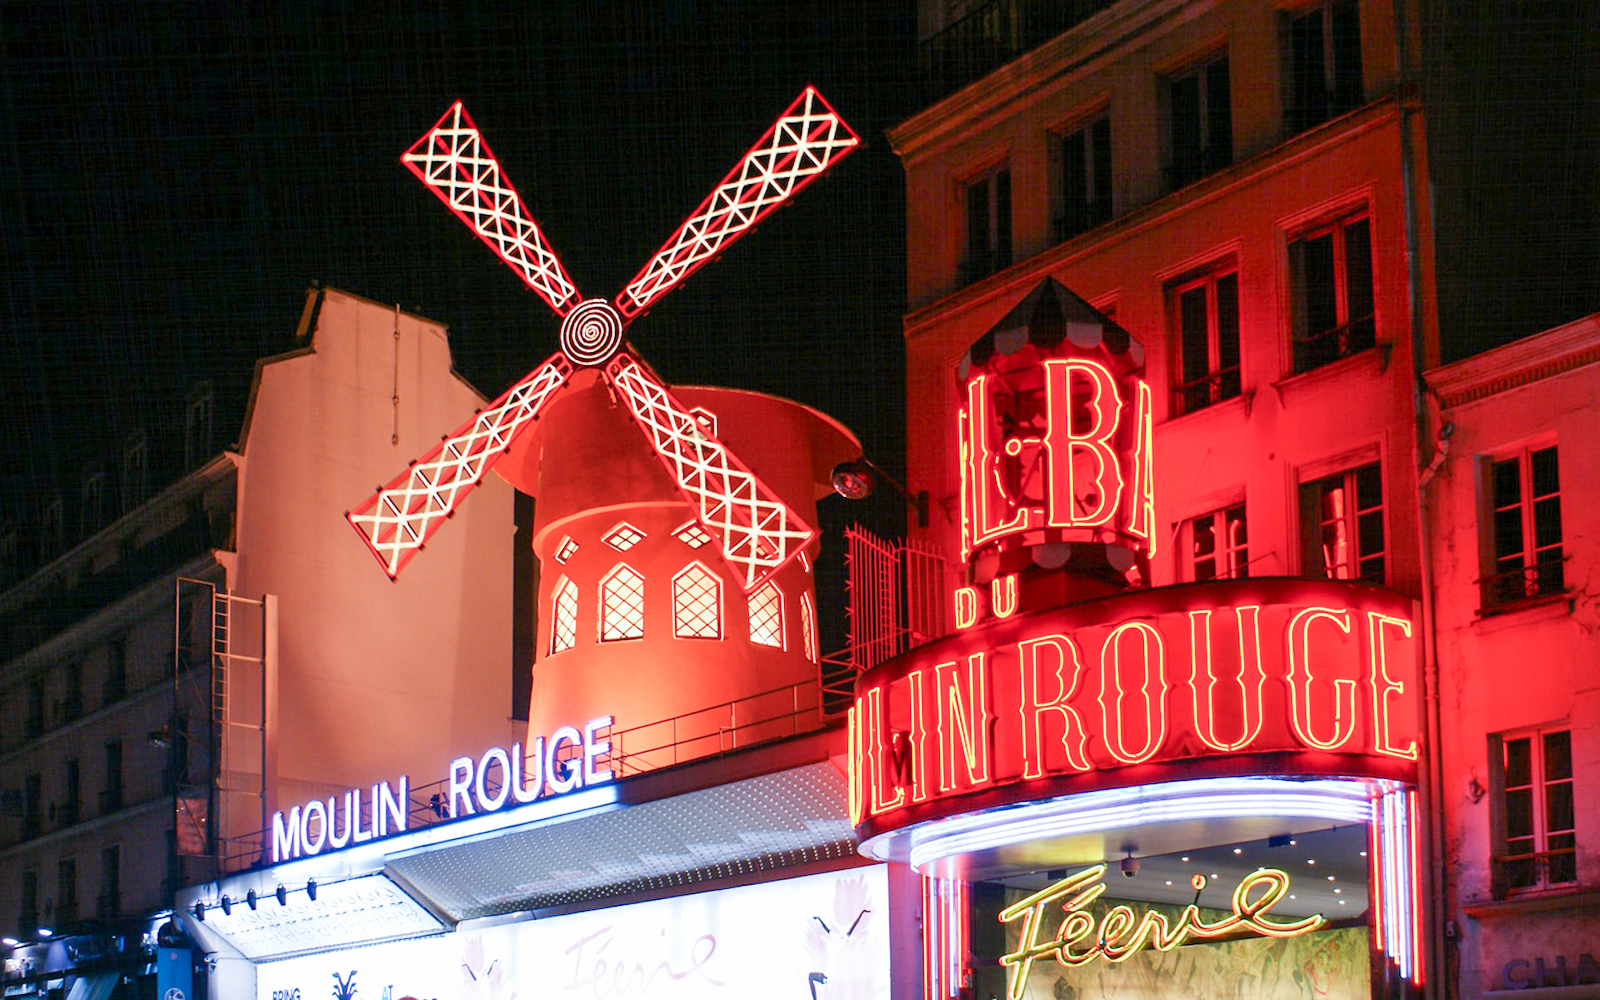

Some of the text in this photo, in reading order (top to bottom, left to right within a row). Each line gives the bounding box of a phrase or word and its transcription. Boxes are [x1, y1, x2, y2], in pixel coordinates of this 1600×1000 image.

[954, 574, 1019, 630] DU
[1017, 604, 1418, 780] ROUGE
[272, 714, 616, 863] MOULIN ROUGE
[998, 864, 1327, 1000] Féerie
